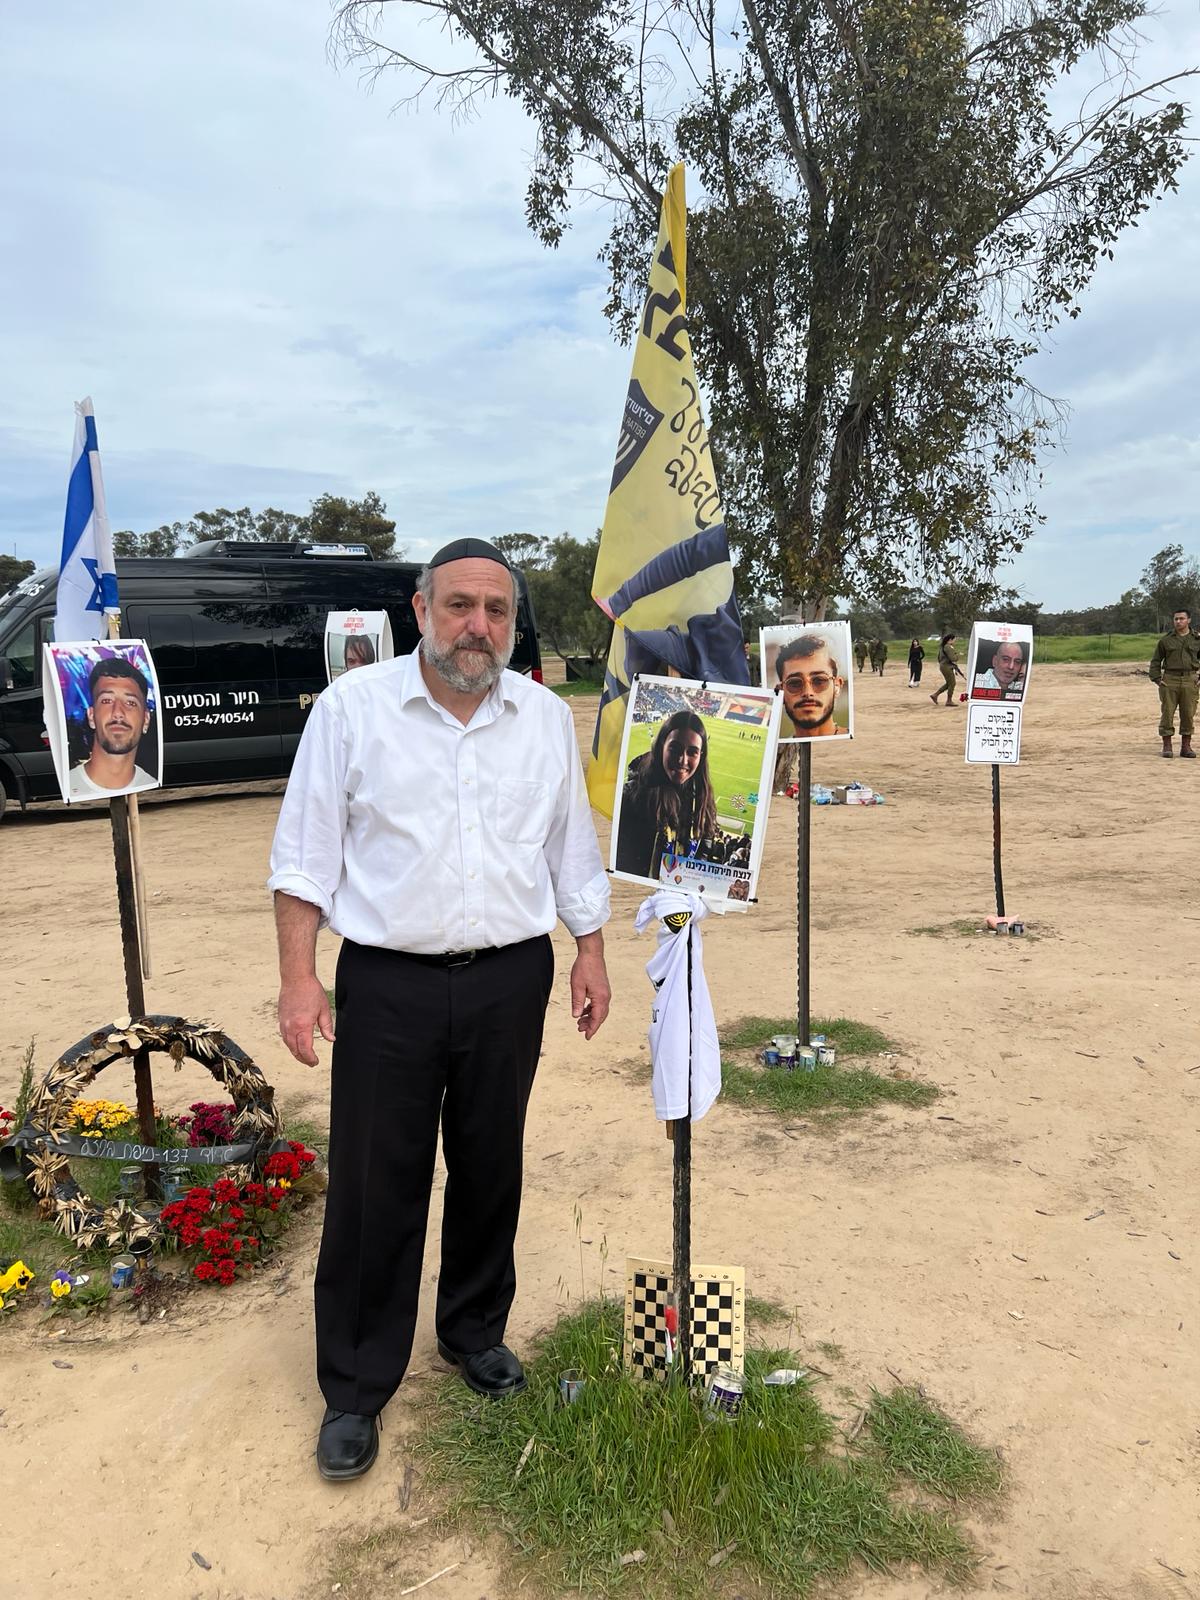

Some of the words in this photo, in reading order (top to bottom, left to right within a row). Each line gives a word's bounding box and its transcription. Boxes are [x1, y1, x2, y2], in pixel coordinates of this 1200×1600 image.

[164, 692, 220, 709] והסעים
[228, 691, 259, 705] תיור
[174, 711, 254, 727] 053-4710541
[685, 860, 707, 872] בליבנו
[733, 869, 751, 880] לנצח
